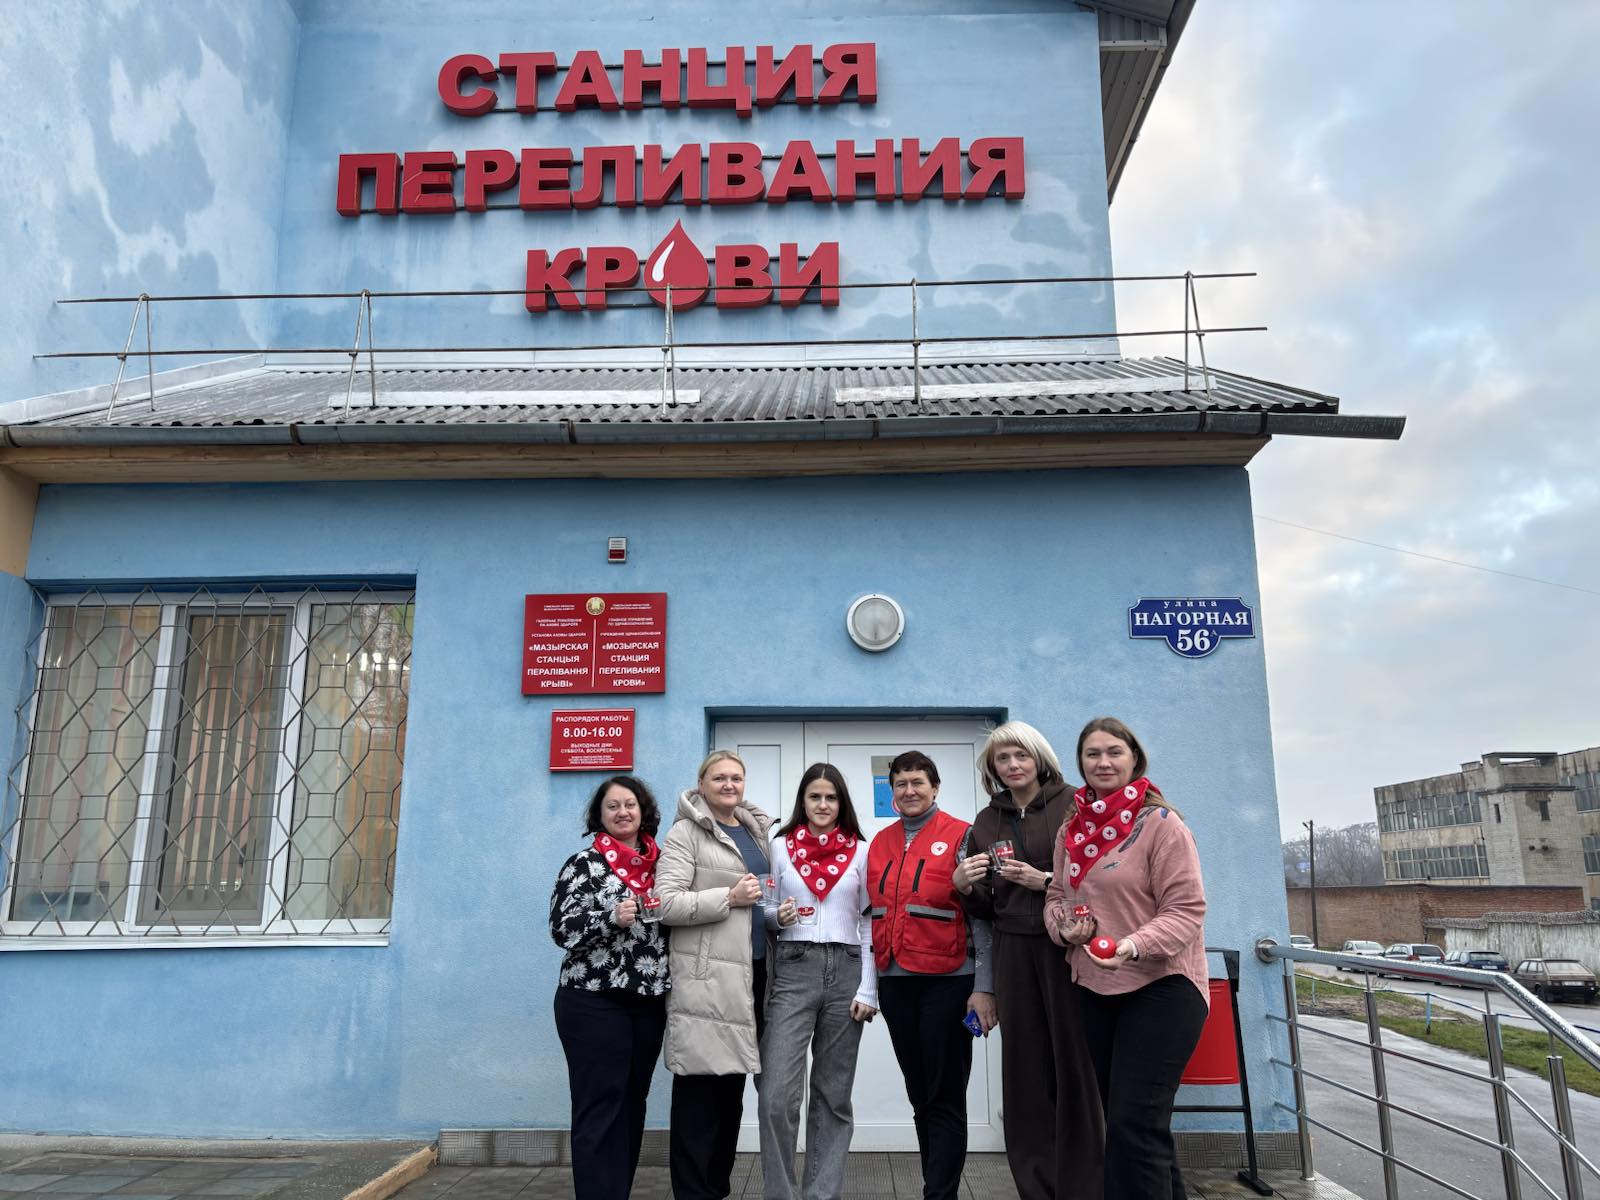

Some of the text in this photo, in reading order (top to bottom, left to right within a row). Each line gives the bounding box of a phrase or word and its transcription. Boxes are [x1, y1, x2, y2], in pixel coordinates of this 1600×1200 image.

[437, 42, 878, 118] СТАНЦИЯ
[336, 137, 1025, 217] ПЕРЕЛИВАНИЯ
[1163, 600, 1217, 608] улица
[1133, 611, 1249, 626] НАГОРНАЯ
[528, 643, 589, 651] «МАЗЫРСКАЯ
[602, 642, 660, 650] «МОЗЫРСКАЯ
[536, 655, 580, 664] СТАНЦЫЯ
[610, 654, 650, 663] СТАНЦИЯ
[599, 666, 661, 675] ПЕРЕЛИВАНИЯ
[612, 679, 646, 687] КРОВИ»
[562, 727, 623, 738] 8.00-16.00
